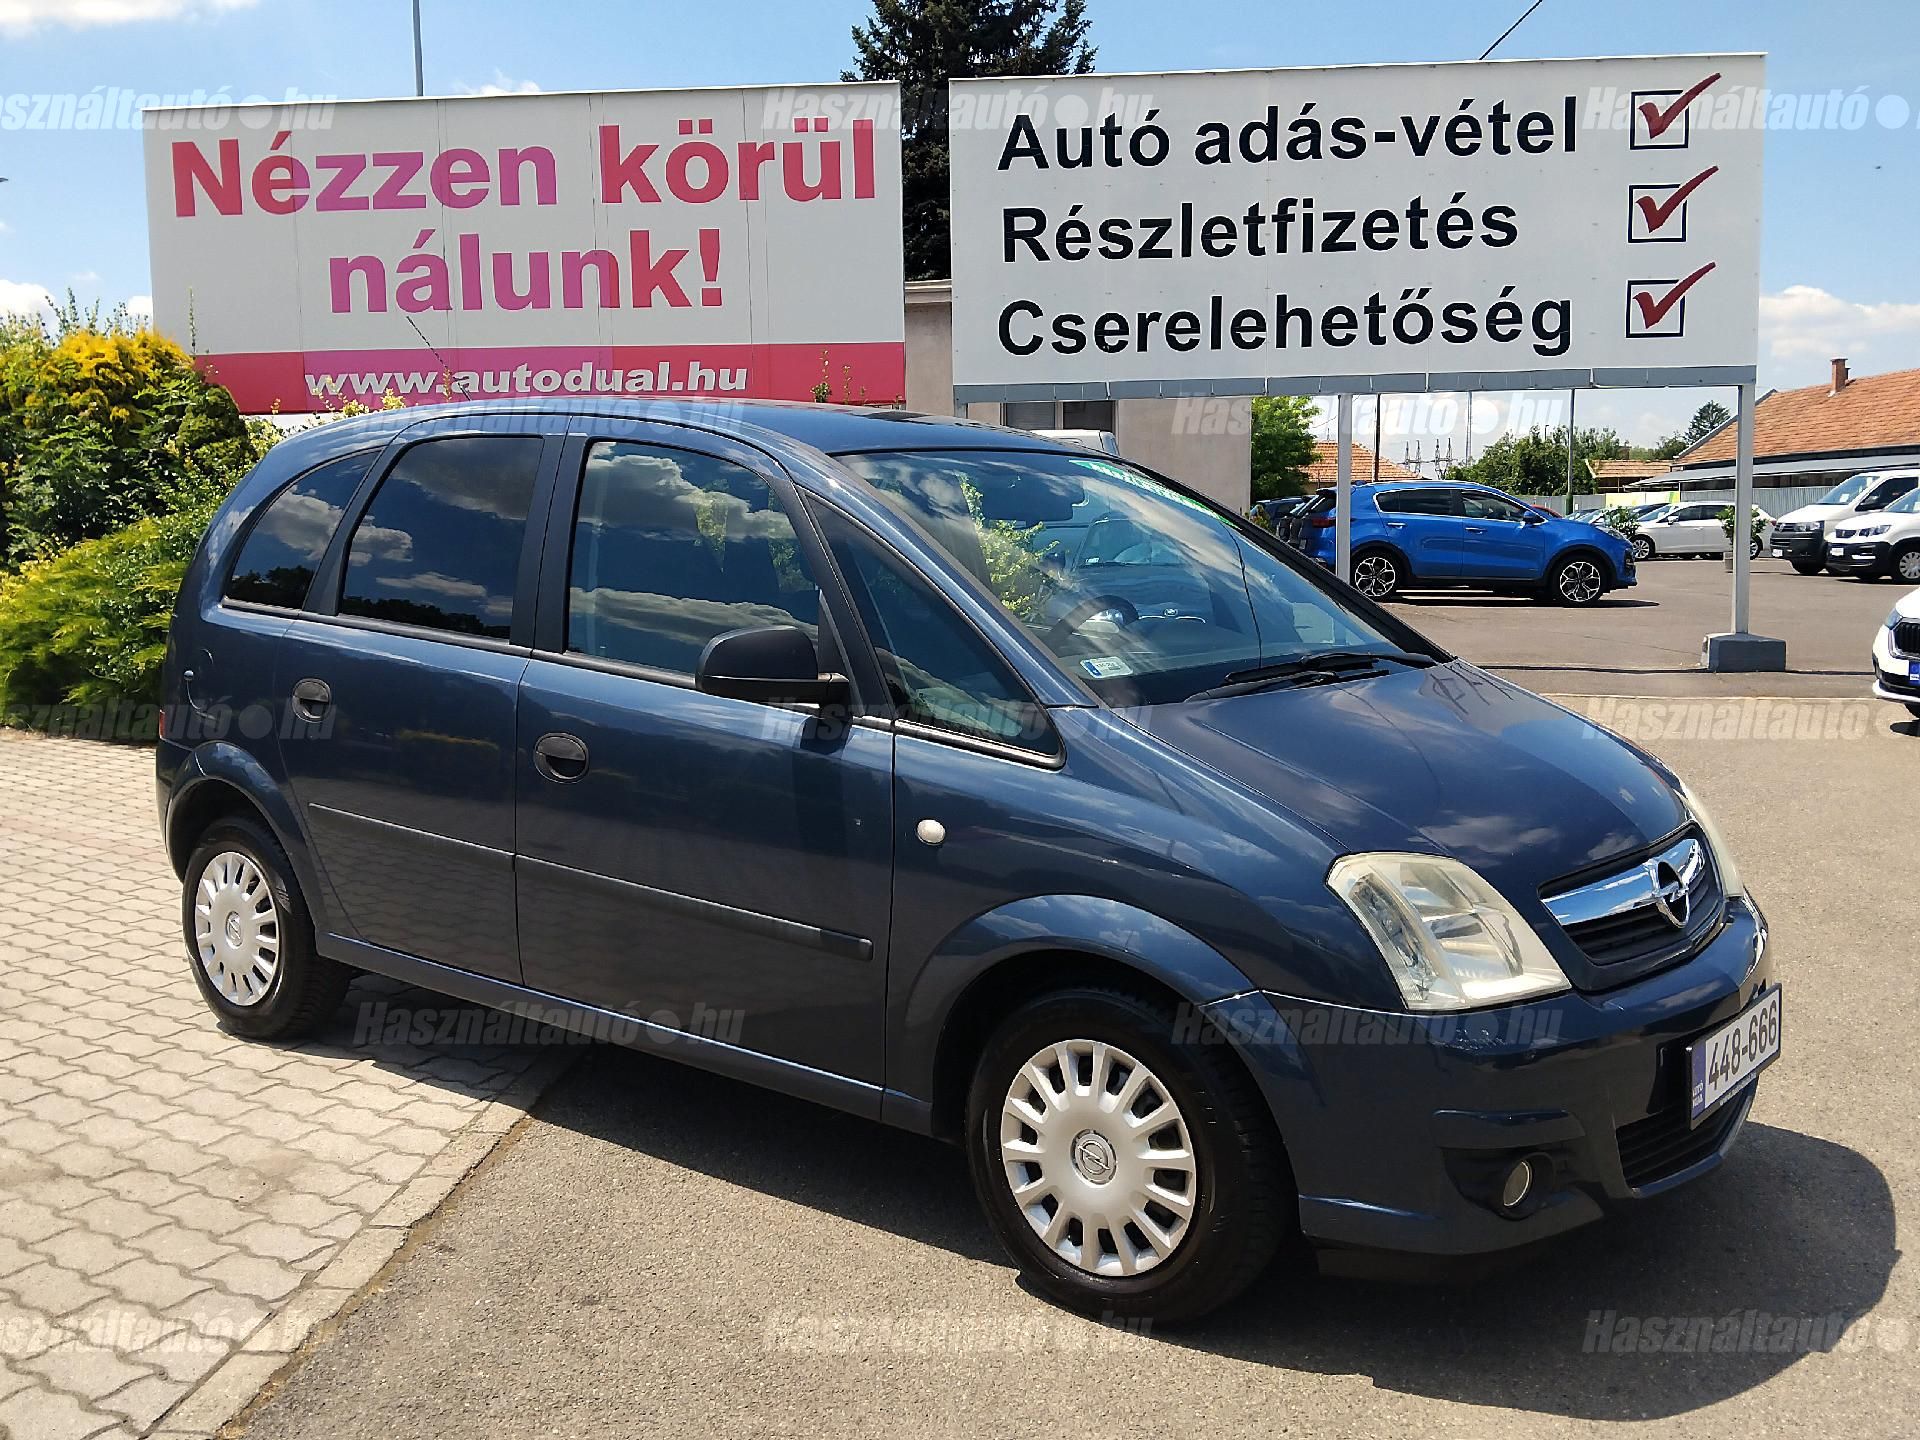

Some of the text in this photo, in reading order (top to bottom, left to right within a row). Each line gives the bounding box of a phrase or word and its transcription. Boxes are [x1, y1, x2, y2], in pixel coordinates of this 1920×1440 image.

[172, 118, 875, 217] Nézzen körül
[998, 96, 1577, 170] Autó adás-vétel
[1004, 192, 1518, 262] Részletfizetés
[330, 229, 722, 313] nálunk!
[999, 286, 1571, 357] Cserelehetőség
[305, 361, 748, 395] www.autodual.hu
[1708, 999, 1777, 1091] 448-666
